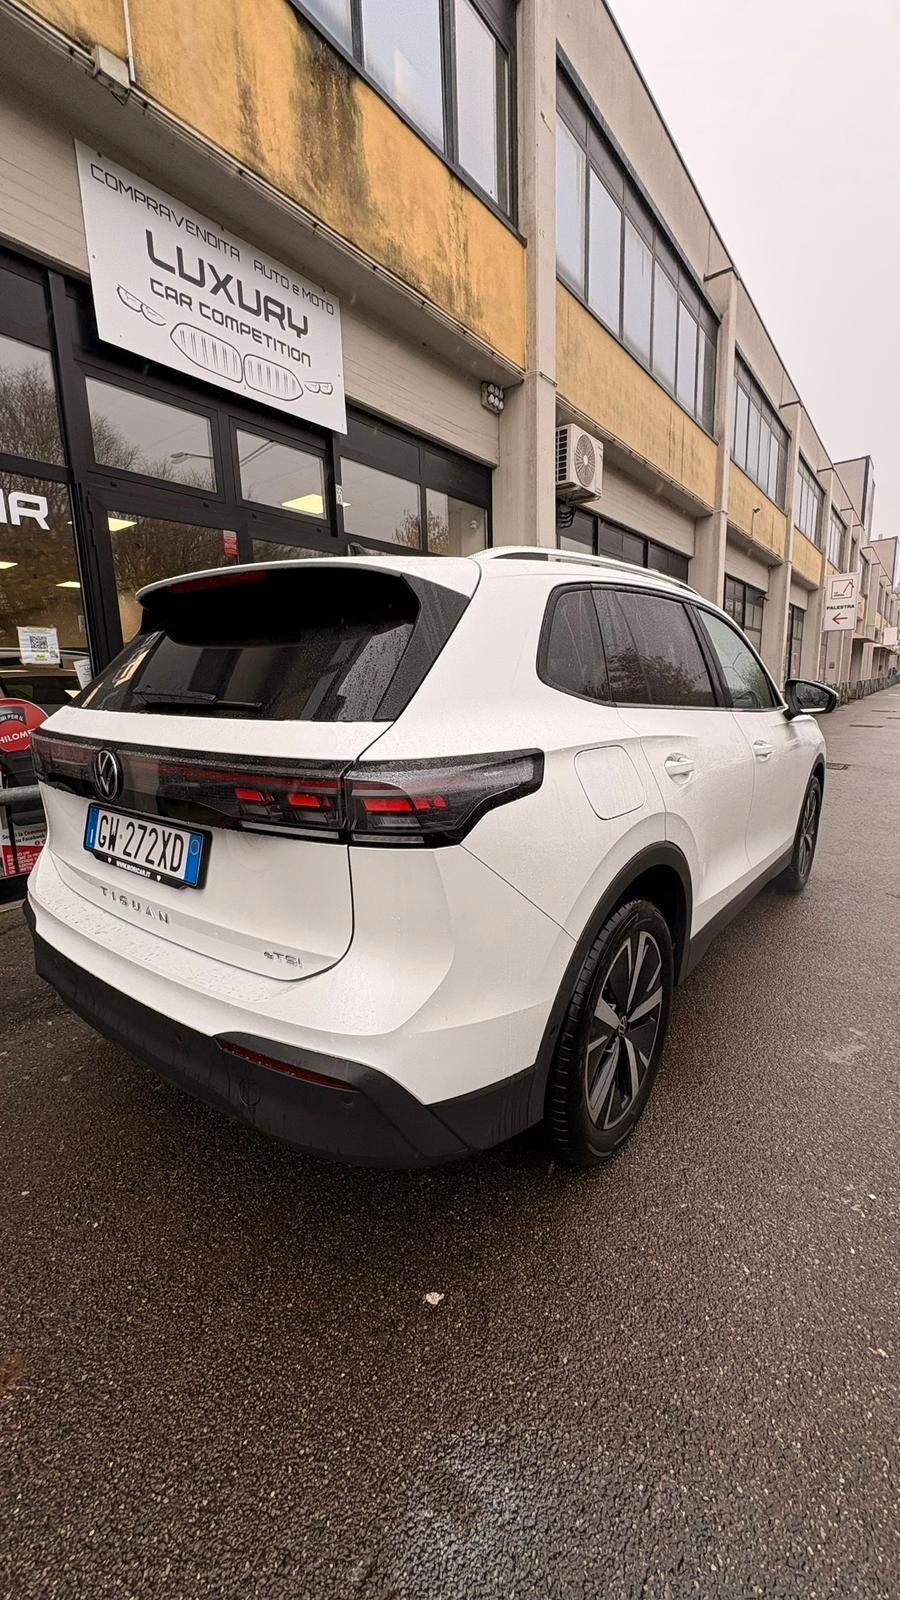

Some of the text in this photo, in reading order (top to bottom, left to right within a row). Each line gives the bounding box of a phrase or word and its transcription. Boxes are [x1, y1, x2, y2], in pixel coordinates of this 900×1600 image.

[90, 163, 335, 316] COMPRAVENDITA AUTO e MOTO
[145, 228, 309, 339] LUXURY
[149, 277, 312, 368] CAR COMPETITION
[100, 885, 169, 924] TIGUAN
